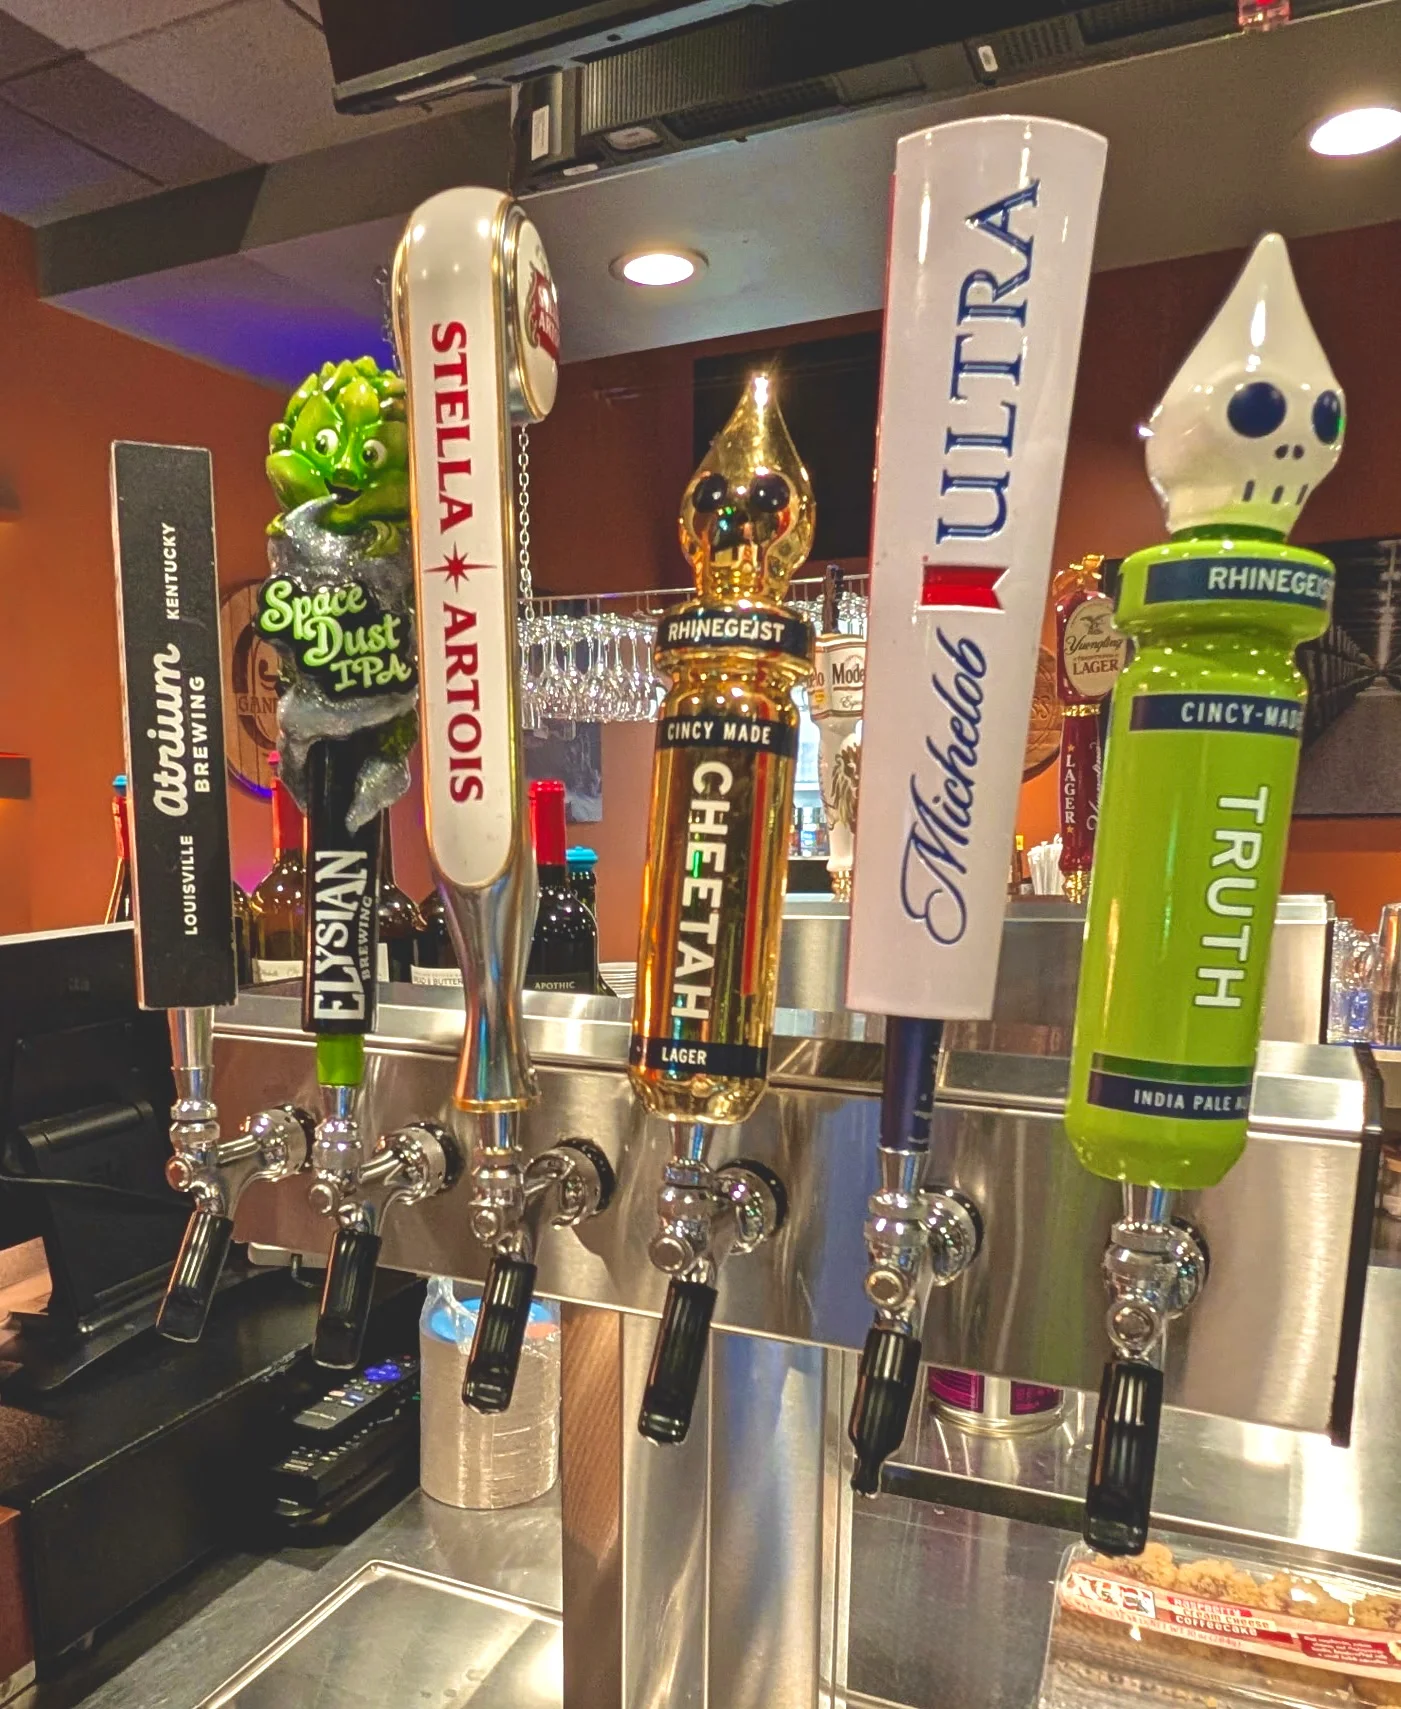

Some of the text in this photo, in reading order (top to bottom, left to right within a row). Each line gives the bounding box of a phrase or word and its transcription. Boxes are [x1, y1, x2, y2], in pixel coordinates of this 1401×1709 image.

[936, 178, 1041, 547] ULTRA
[165, 522, 179, 620] KENTUCKY
[430, 321, 484, 804] STELLA ARTOIS
[260, 579, 367, 636] Space
[303, 614, 402, 668] Dust
[667, 616, 785, 643] RHINEGEIST
[1065, 635, 1124, 656] Yuengling
[334, 655, 411, 691] IPA
[1073, 659, 1119, 675] LAGER
[148, 643, 190, 817] atrium
[191, 676, 210, 793] BREWING
[667, 721, 771, 746] CINCY MADE
[901, 626, 987, 946] Michelob
[1064, 753, 1076, 824] LAGER
[184, 833, 198, 935] LOUISVILLE
[671, 761, 733, 1020] CHEETAH
[1195, 786, 1268, 1011] TRUTH
[314, 850, 367, 1022] ELYSIAN
[361, 896, 373, 979] BREWING
[534, 980, 575, 990] APOTHIC
[661, 1046, 707, 1066] LAGER
[1134, 1088, 1185, 1110] INDIA
[1193, 1095, 1231, 1112] PALE
